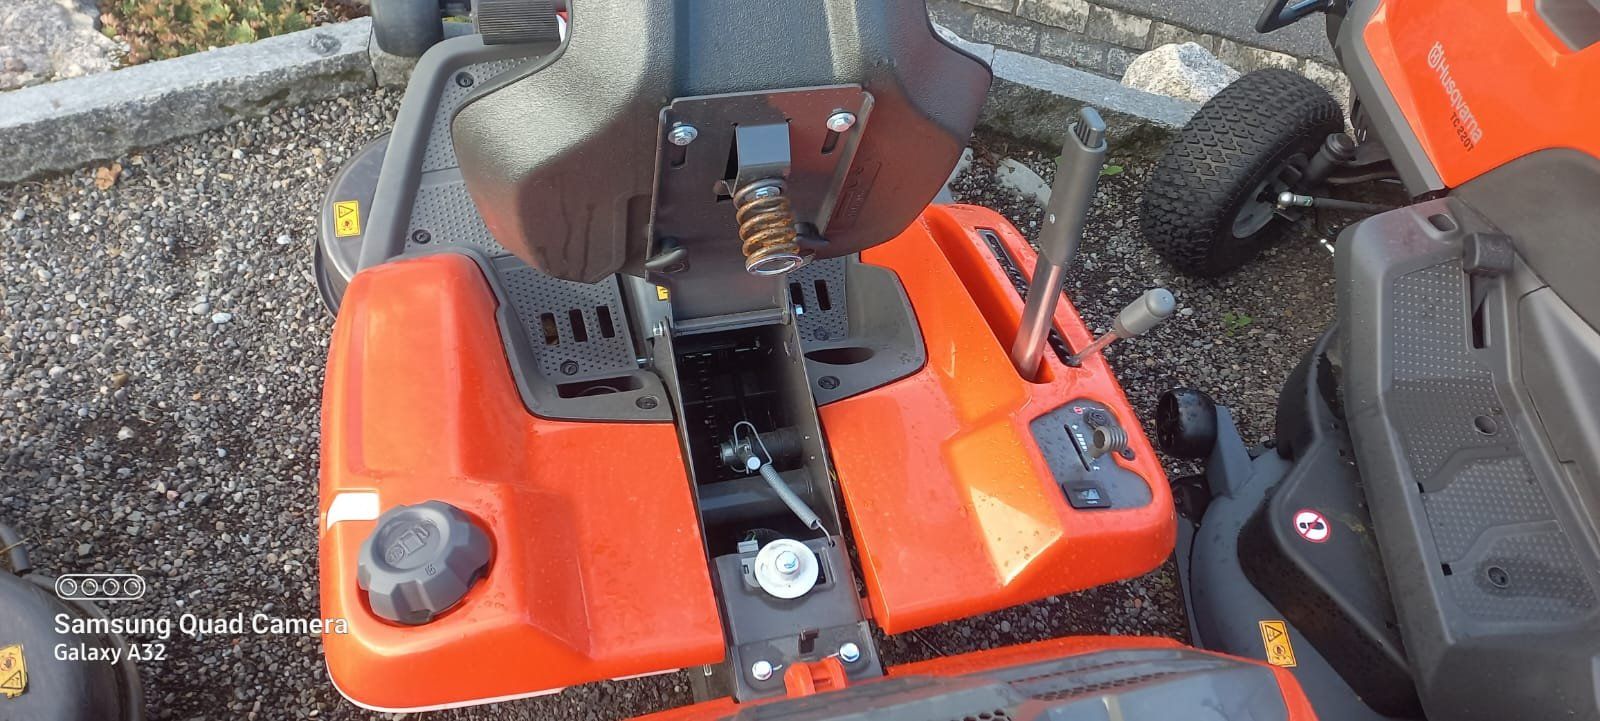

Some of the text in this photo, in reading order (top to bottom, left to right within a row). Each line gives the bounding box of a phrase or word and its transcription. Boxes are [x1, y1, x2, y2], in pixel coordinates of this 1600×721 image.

[1435, 56, 1483, 145] Husqvarna
[1450, 111, 1475, 152] TC 220T
